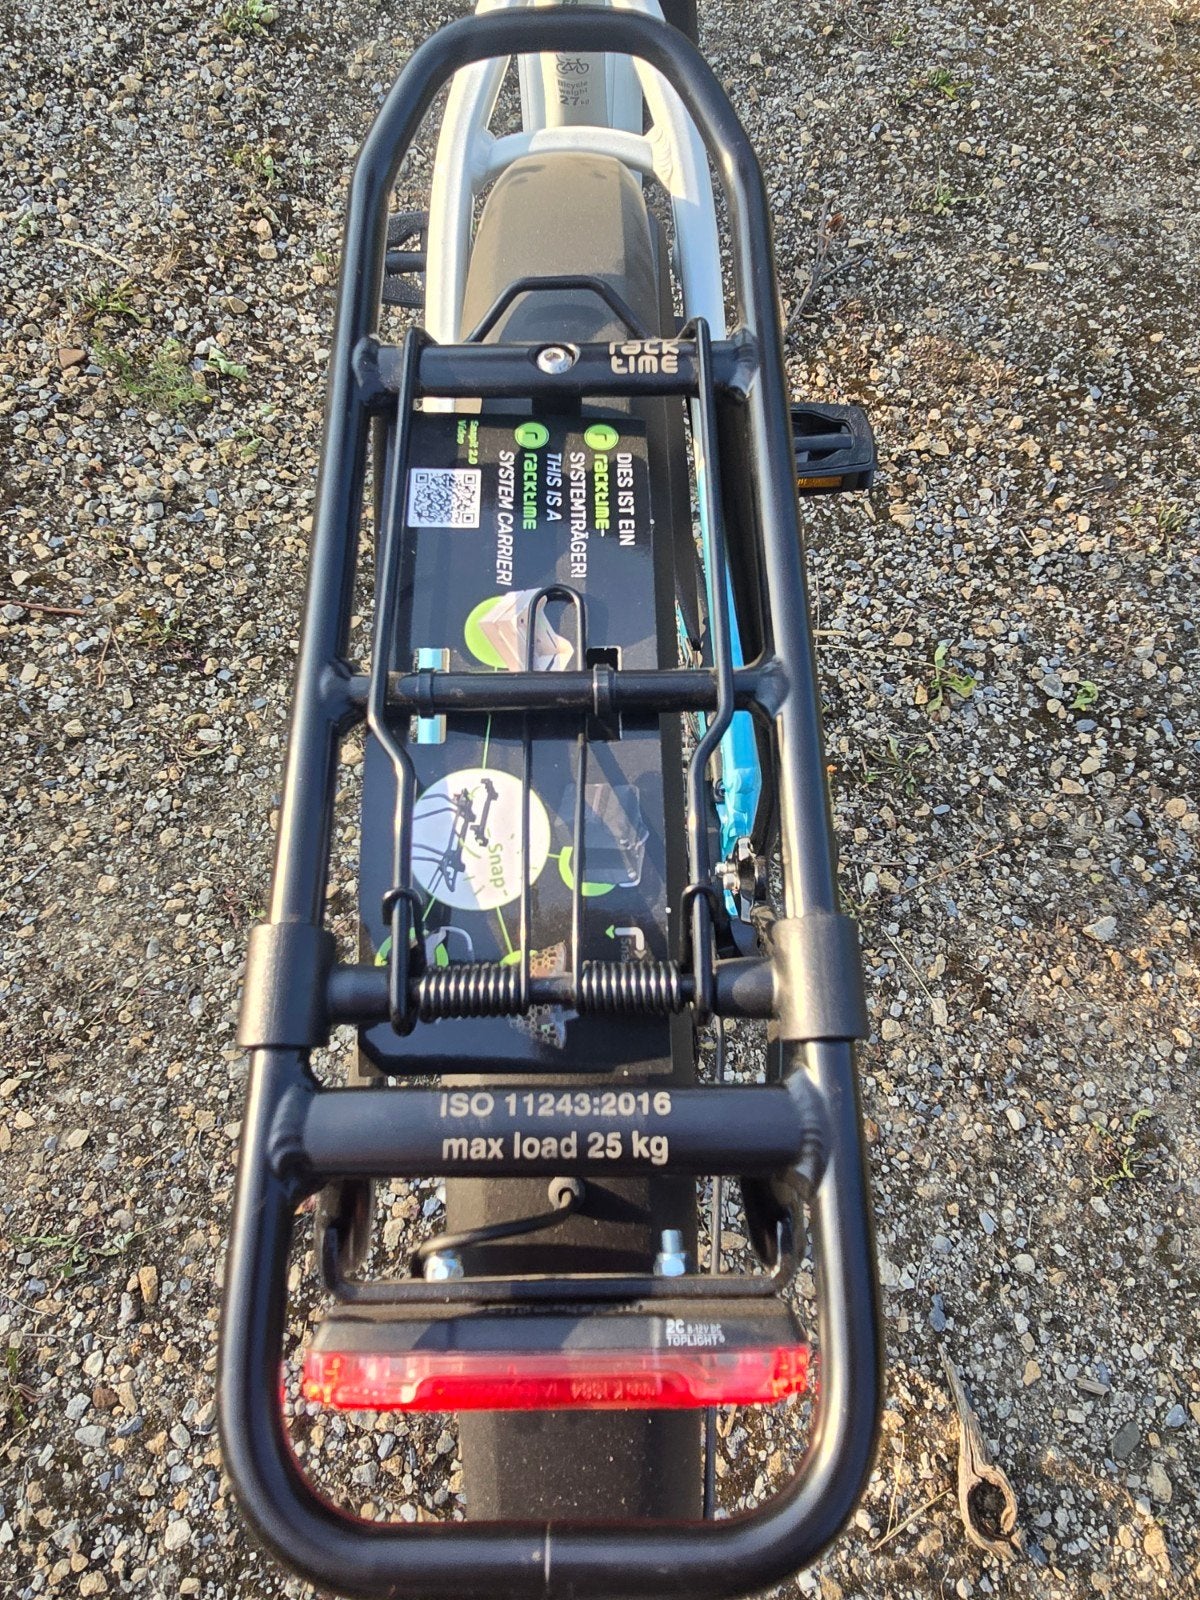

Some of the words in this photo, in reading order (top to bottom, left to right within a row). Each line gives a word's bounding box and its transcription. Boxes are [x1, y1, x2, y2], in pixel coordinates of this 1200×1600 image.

[558, 80, 588, 89] Bicycle
[560, 96, 579, 105] 27
[609, 340, 680, 355] rack
[456, 420, 467, 445] Video
[498, 449, 515, 510] SYSTEM
[546, 452, 562, 488] THIS
[616, 452, 634, 488] DIES
[546, 490, 562, 507] IS
[618, 490, 635, 516] IST
[546, 508, 562, 521] A
[569, 451, 589, 578] SYSTEMTRÄGER!
[618, 518, 636, 546] EIN
[496, 511, 514, 586] CARRIER!
[487, 843, 506, 888] Snap
[440, 1092, 495, 1118] ISO
[505, 1091, 672, 1117] 11243:2016
[442, 1136, 504, 1161] max
[513, 1130, 578, 1160] load
[586, 1131, 623, 1160] 25
[631, 1130, 669, 1166] kg
